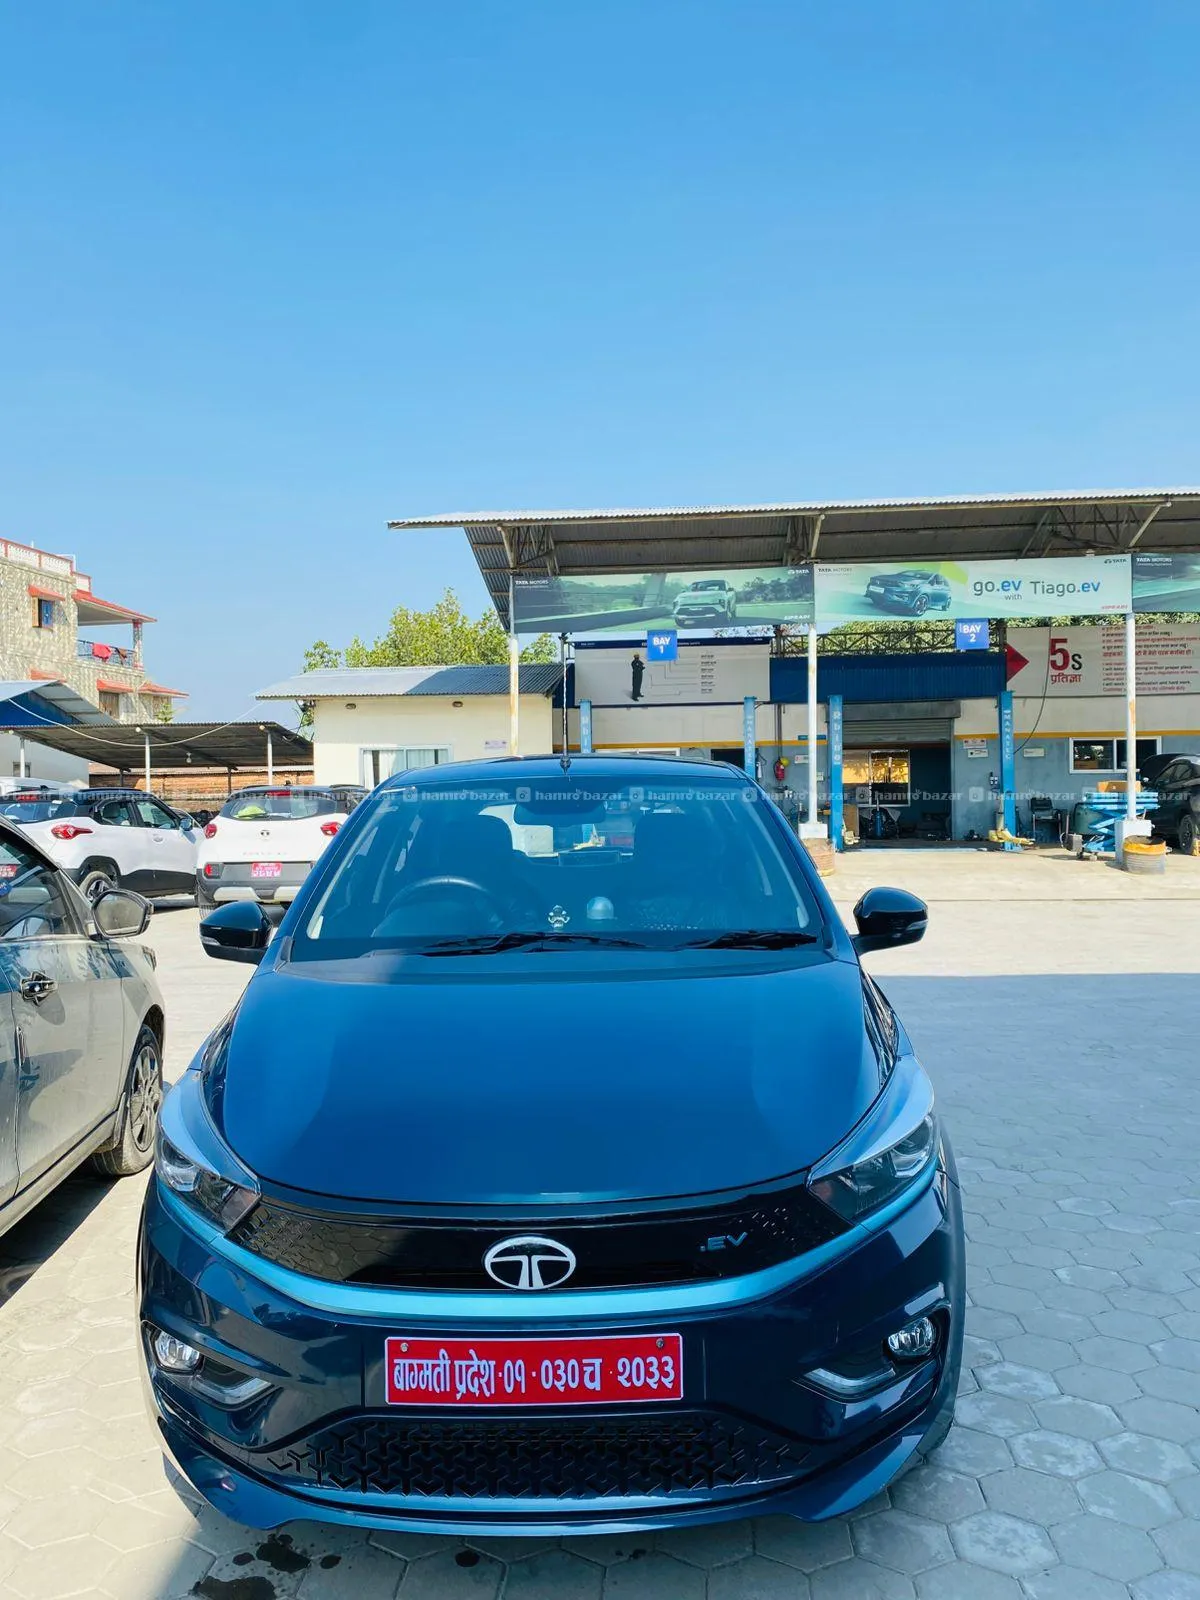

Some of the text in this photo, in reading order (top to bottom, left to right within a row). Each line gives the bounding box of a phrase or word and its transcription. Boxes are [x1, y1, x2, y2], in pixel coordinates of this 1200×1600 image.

[973, 580, 1100, 597] go.ev Tiago.ev
[963, 624, 981, 633] BAY
[653, 637, 671, 646] BAY
[970, 633, 976, 642] 2
[660, 645, 664, 654] 1
[1051, 672, 1082, 684] प्रतिज्ञा
[454, 1349, 496, 1400] प्रदेश
[617, 1355, 675, 1389] २०३३
